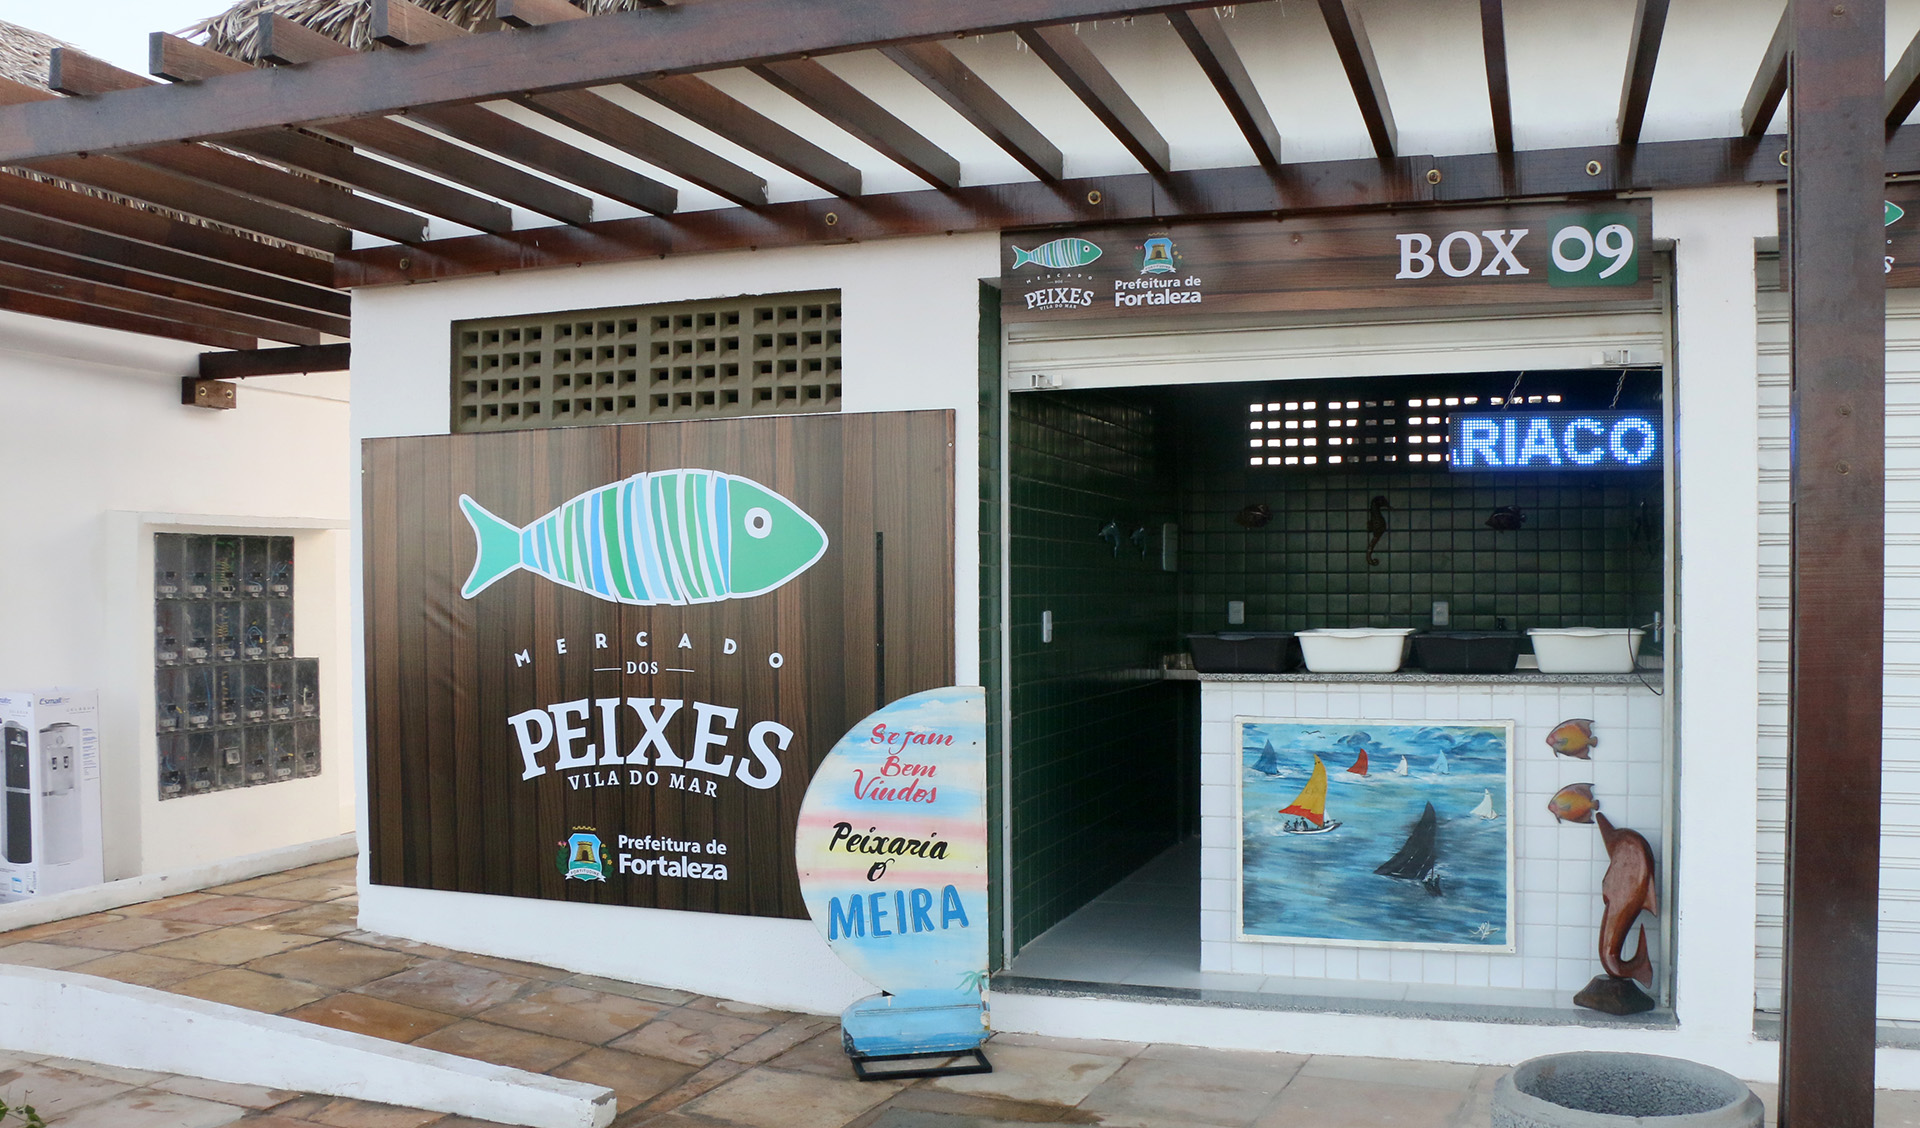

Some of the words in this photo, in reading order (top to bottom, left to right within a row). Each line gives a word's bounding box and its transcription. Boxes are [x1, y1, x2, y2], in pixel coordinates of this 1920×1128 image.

[1395, 228, 1530, 280] BOX
[1551, 223, 1634, 280] 09
[1026, 273, 1093, 284] MERCADO
[1114, 277, 1182, 290] Prefeitura
[1184, 275, 1202, 287] de
[1024, 287, 1095, 310] PEIXES
[1114, 288, 1202, 307] Fortaleza
[514, 631, 784, 669] MERCADO
[626, 661, 659, 675] DOS
[507, 696, 795, 790] PEIXES
[870, 723, 957, 756] Sejam
[880, 755, 938, 778] Bem
[567, 769, 620, 791] VILA
[629, 769, 659, 786] DO
[669, 772, 718, 798] MAR
[853, 768, 938, 804] Vindos
[618, 834, 701, 854] Prefeitura
[706, 839, 728, 855] de
[828, 821, 951, 860] Peixaria
[618, 853, 729, 881] Fortaleza
[828, 884, 970, 942] MEIRA
